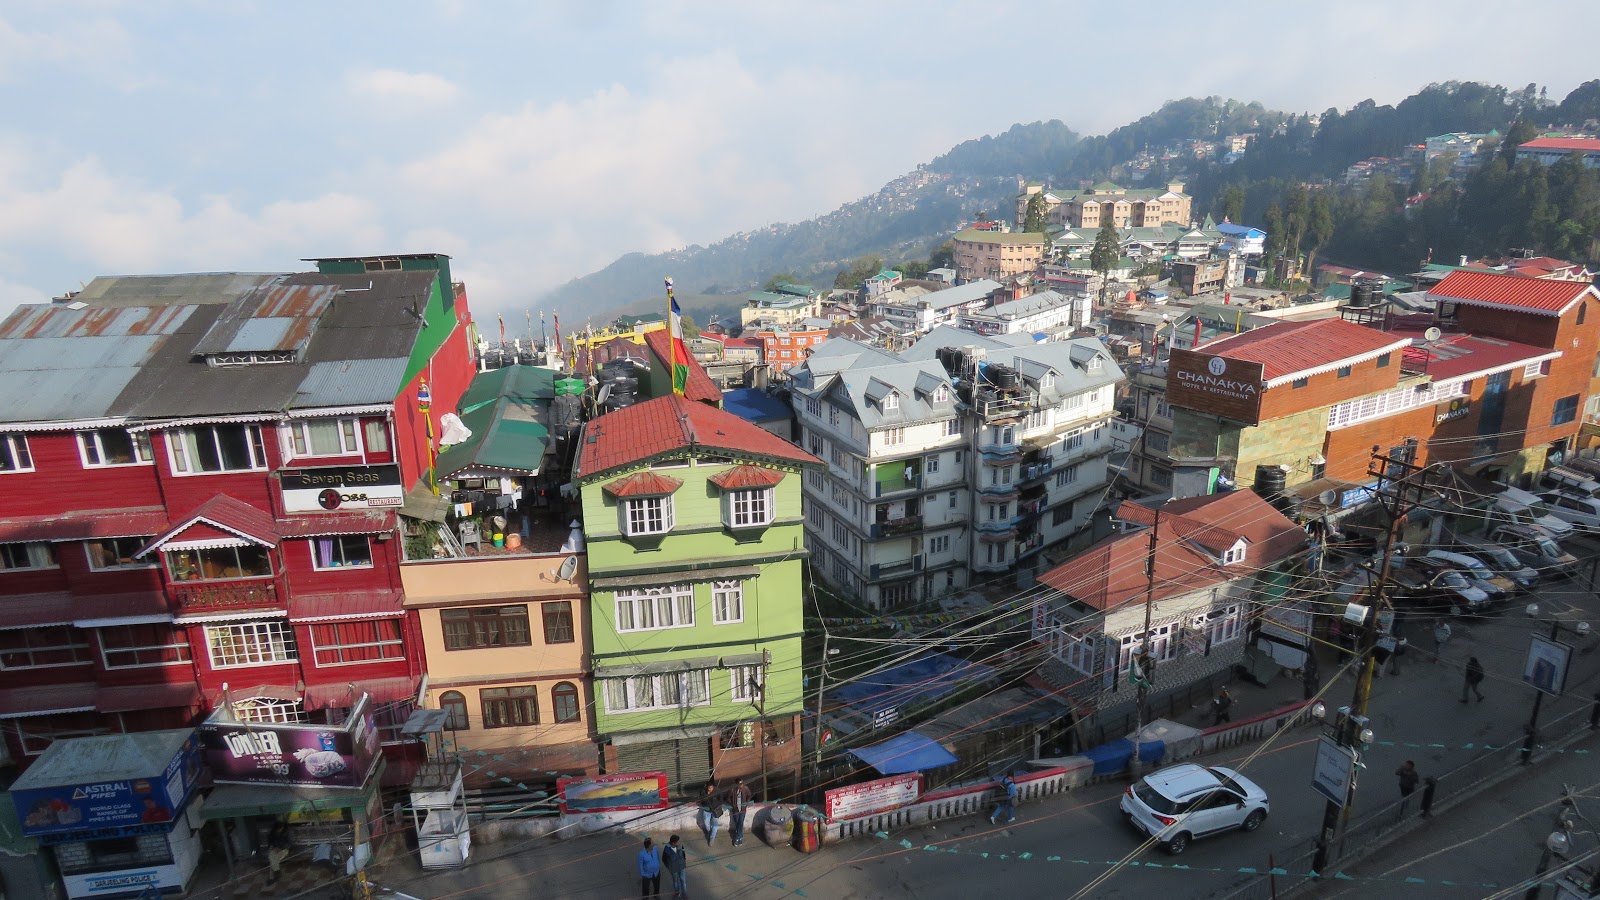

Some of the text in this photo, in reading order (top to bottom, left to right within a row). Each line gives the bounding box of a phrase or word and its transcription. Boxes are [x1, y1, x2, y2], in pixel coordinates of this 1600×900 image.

[1177, 371, 1256, 394] CHANAKYA
[1181, 382, 1200, 390] HOTEL
[1210, 387, 1249, 400] RESTAURANT
[1436, 407, 1470, 422] CHANAKYA
[302, 472, 380, 485] Seven Seas
[369, 498, 401, 506] RESTAURANT
[223, 731, 283, 759] LONGER
[85, 782, 128, 794] ASTRAL
[91, 791, 116, 800] PIPES
[112, 813, 138, 821] FITTINGS
[94, 875, 151, 888] DARJEELING POLICE
